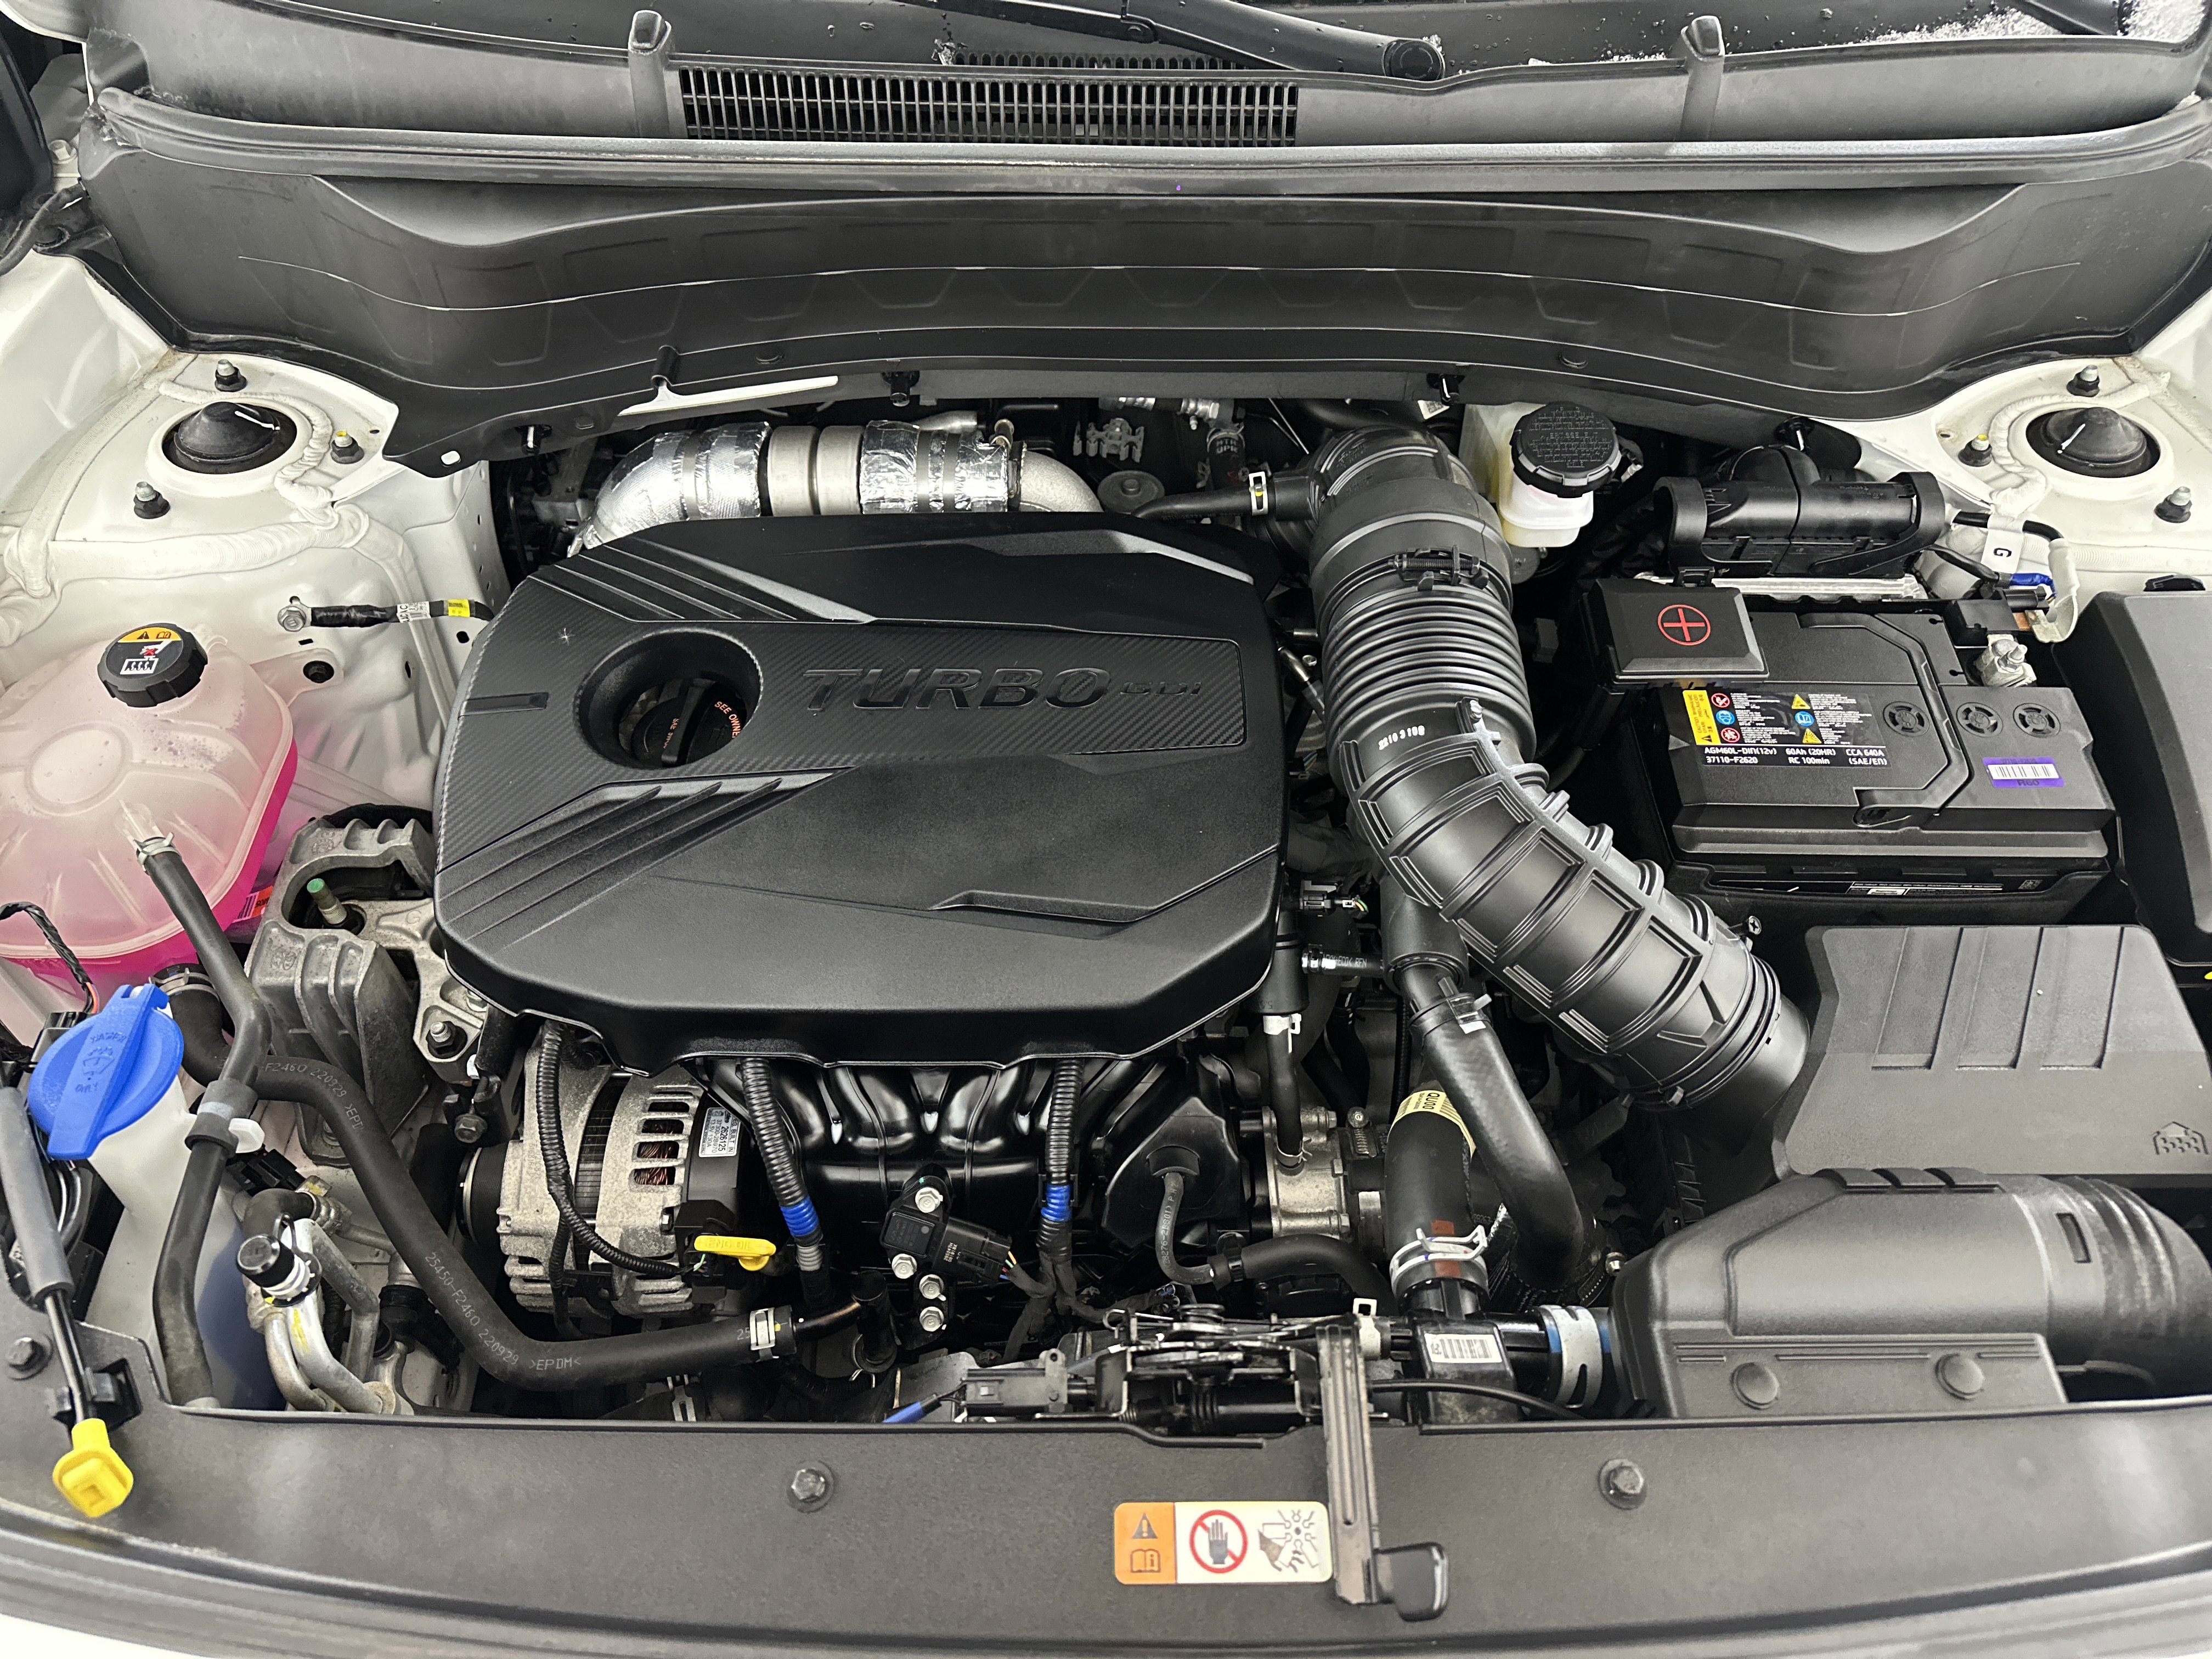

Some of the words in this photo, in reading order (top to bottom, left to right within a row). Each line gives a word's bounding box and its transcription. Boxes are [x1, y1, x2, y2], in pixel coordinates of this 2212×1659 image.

[1993, 548, 2012, 557] G
[803, 667, 1111, 710] TURBO
[714, 701, 732, 714] SEE
[718, 1126, 729, 1152] 2626125
[707, 1237, 732, 1249] ENG
[735, 1240, 753, 1251] OIL
[425, 1252, 481, 1327] 25450-F2460
[478, 1328, 520, 1365] 220929
